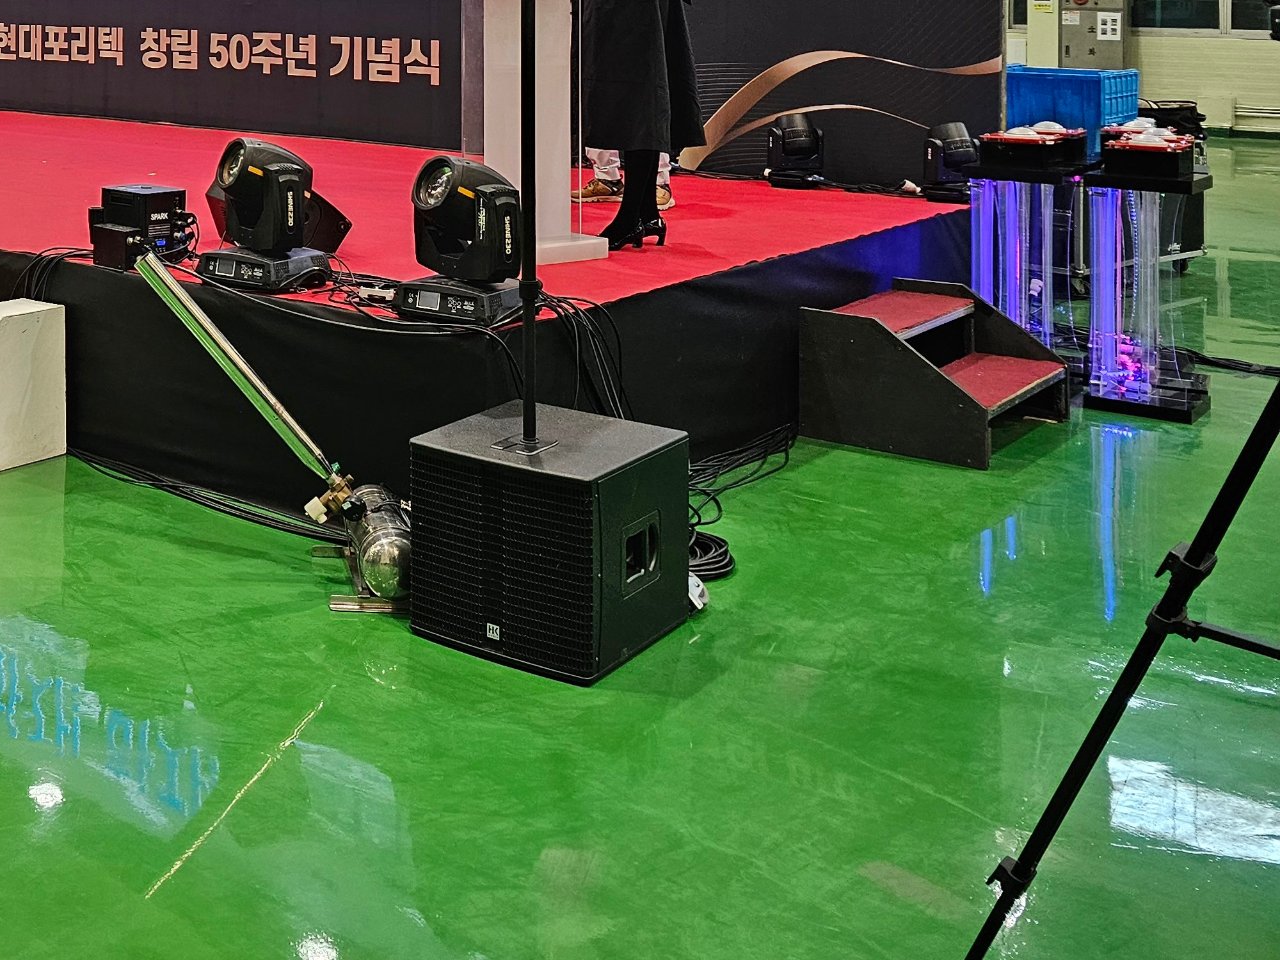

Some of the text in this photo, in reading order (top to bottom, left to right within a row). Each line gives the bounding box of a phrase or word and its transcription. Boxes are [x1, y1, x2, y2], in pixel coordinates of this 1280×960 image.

[140, 27, 198, 70] 창립
[208, 31, 317, 78] 50주년
[329, 36, 440, 86] 기념식
[150, 212, 169, 221] SPARK
